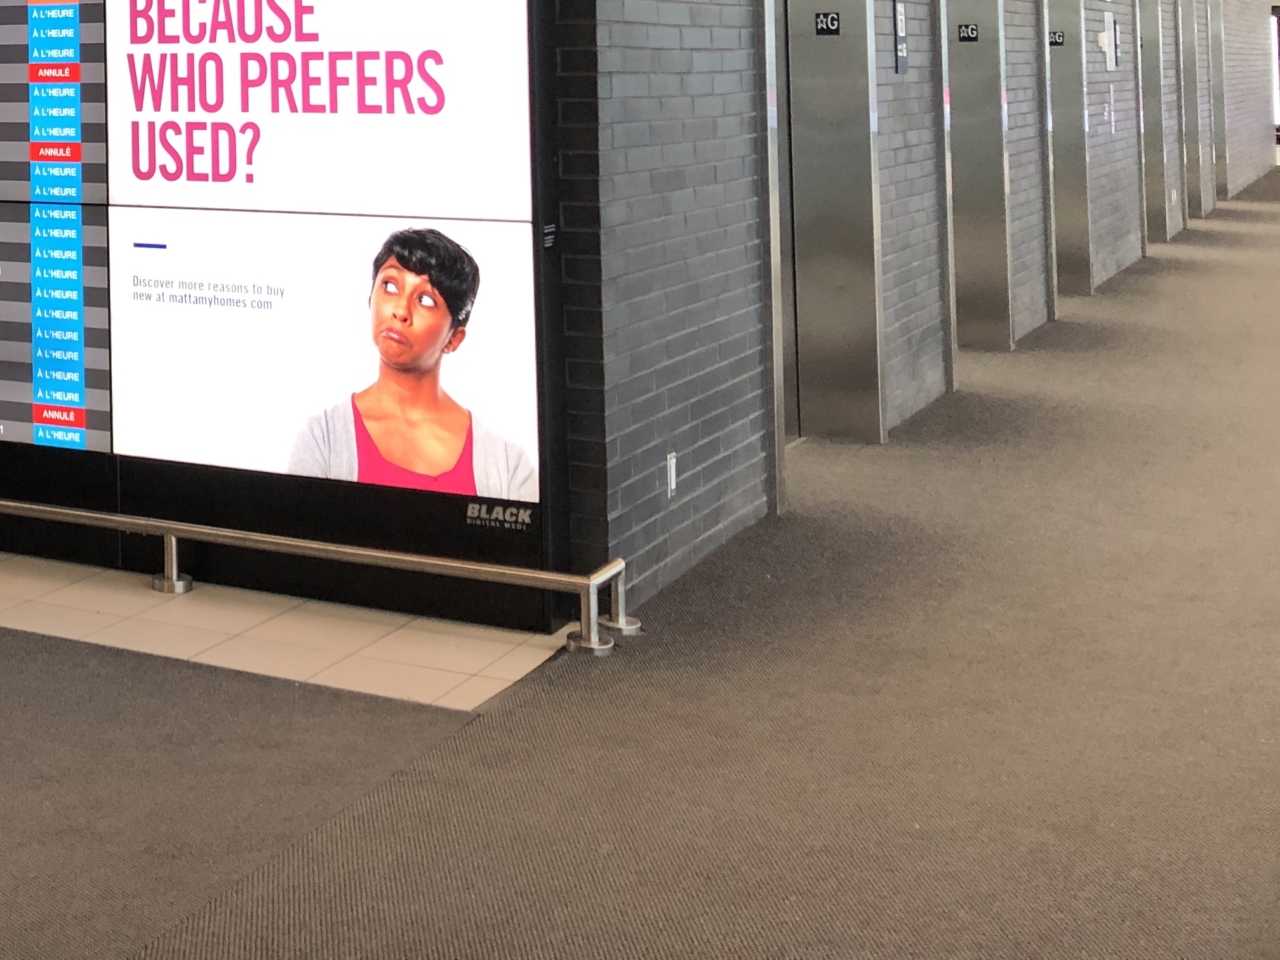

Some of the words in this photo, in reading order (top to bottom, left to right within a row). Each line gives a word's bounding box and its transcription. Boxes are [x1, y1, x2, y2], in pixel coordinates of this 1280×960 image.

[38, 67, 69, 77] ANNULÉ
[127, 52, 221, 113] WHO
[240, 49, 445, 115] PREFERS
[34, 126, 40, 135] À
[42, 128, 75, 136] L'HEURE
[130, 121, 261, 184] USED?
[133, 275, 174, 289] Discover
[178, 281, 204, 290] more
[208, 282, 249, 294] reasons
[253, 284, 262, 294] to
[267, 284, 284, 298] buy
[133, 292, 152, 300] new
[156, 292, 165, 302] at
[38, 427, 44, 437] À
[46, 431, 80, 442] L'HEURE
[467, 504, 532, 524] BLACK
